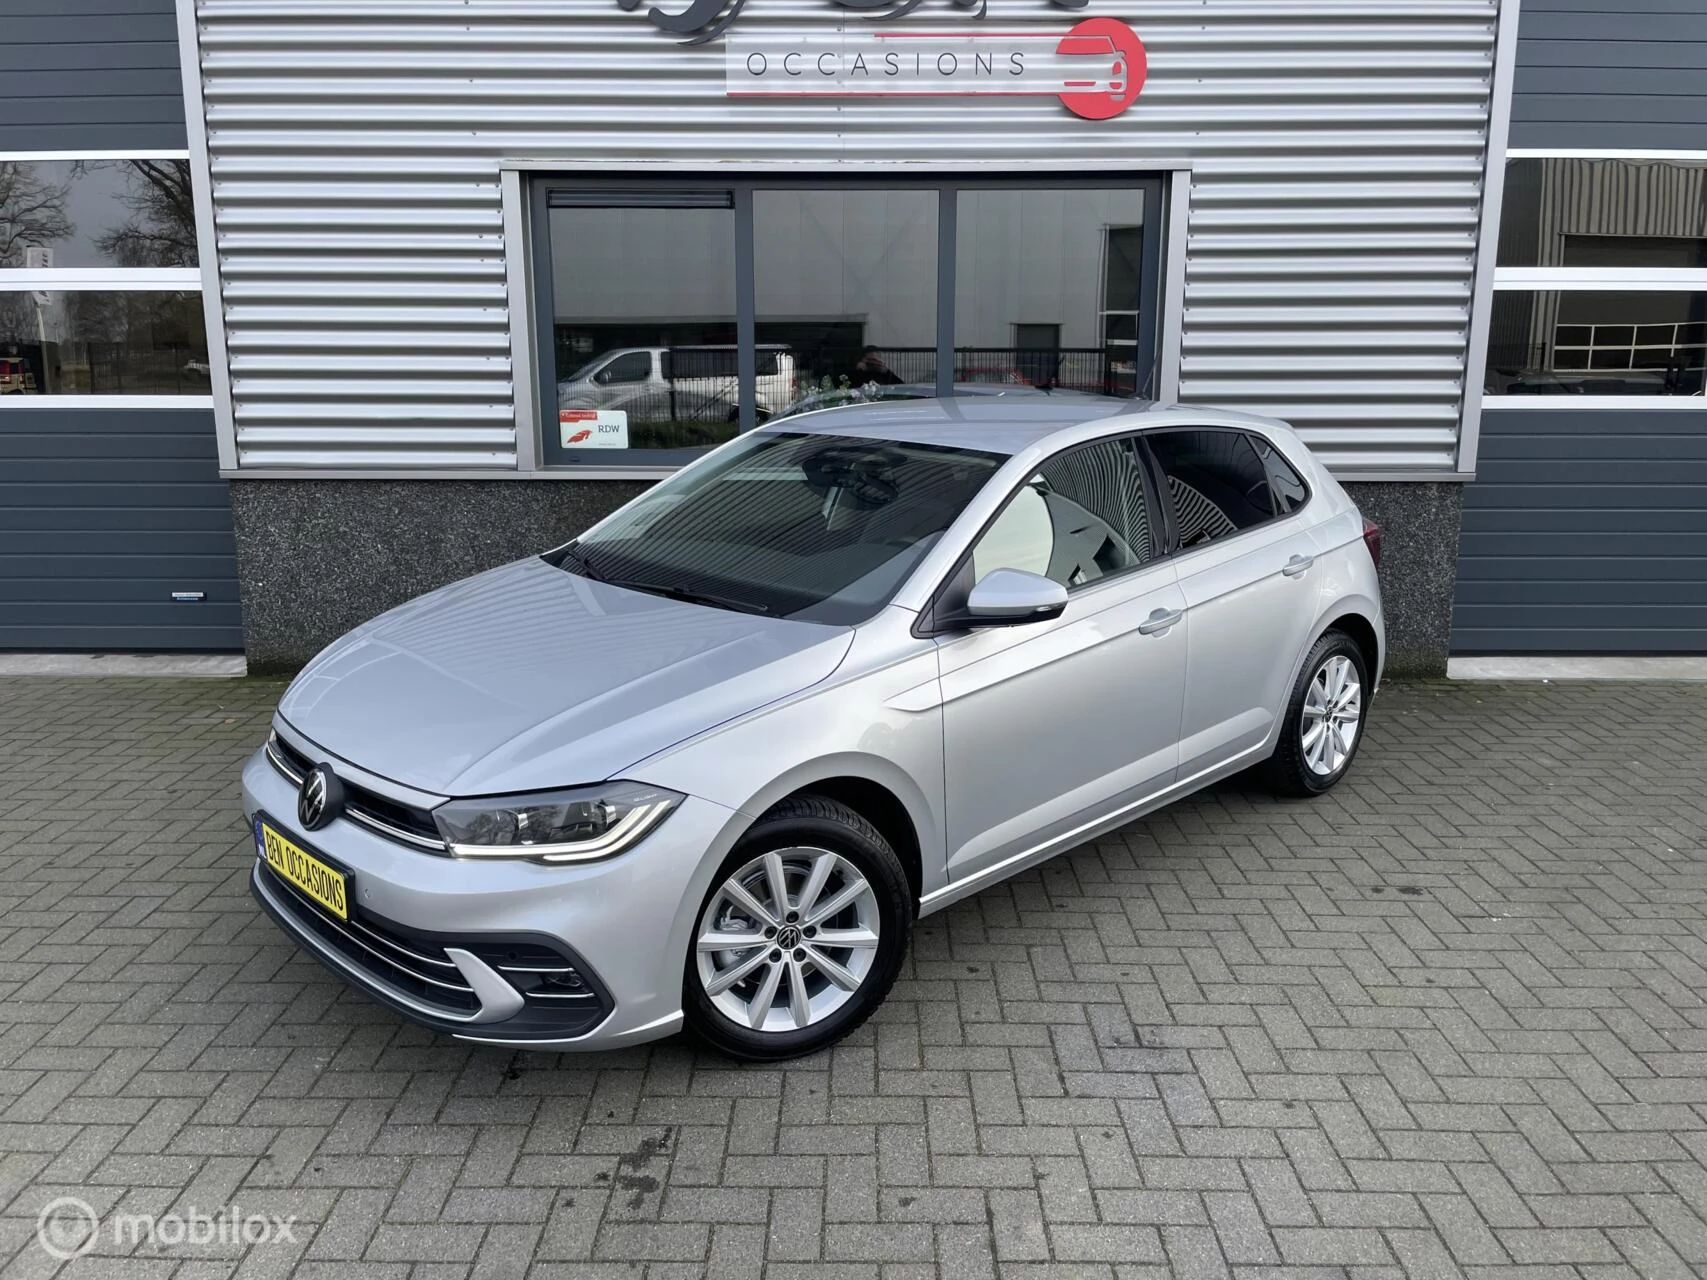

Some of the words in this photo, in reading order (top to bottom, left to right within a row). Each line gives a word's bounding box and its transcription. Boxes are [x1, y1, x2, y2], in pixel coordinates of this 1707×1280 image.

[746, 52, 1025, 76] OCCASIONS
[598, 424, 620, 433] RDW
[265, 830, 284, 870] BEN
[286, 846, 344, 911] OCCASIONS
